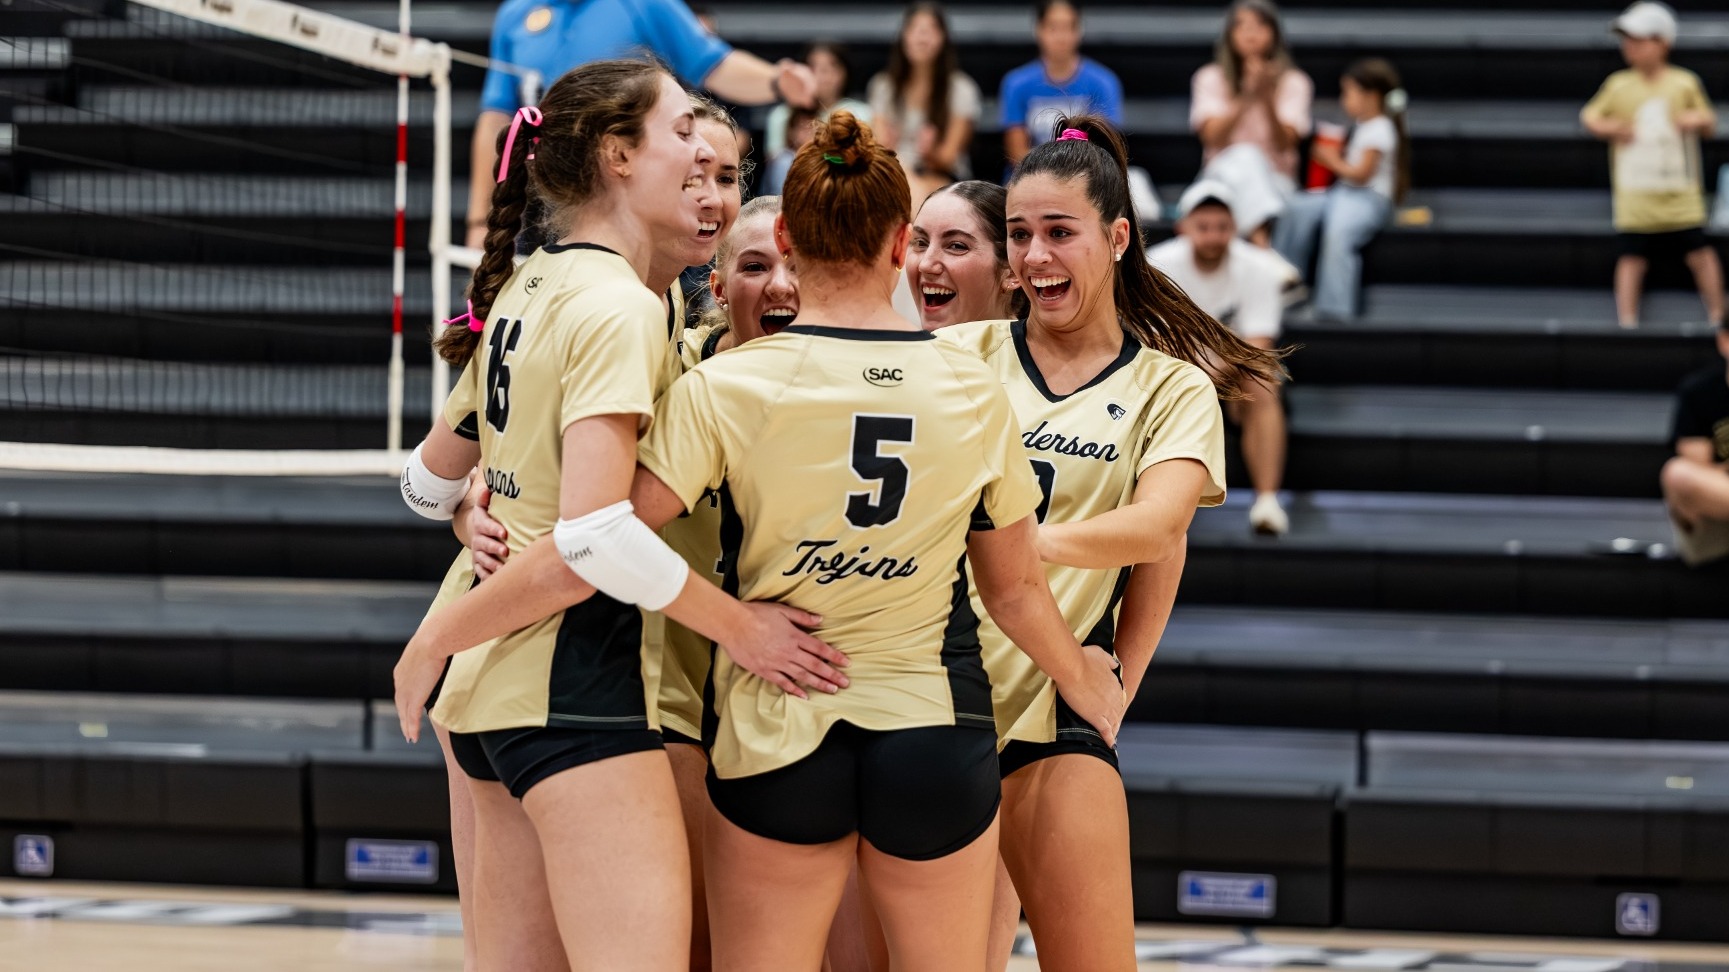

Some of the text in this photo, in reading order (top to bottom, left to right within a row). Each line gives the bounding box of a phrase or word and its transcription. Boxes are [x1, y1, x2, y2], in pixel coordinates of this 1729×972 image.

[485, 316, 523, 435] 16
[868, 367, 904, 382] SAC
[844, 414, 914, 529] 5
[1021, 420, 1120, 463] derson
